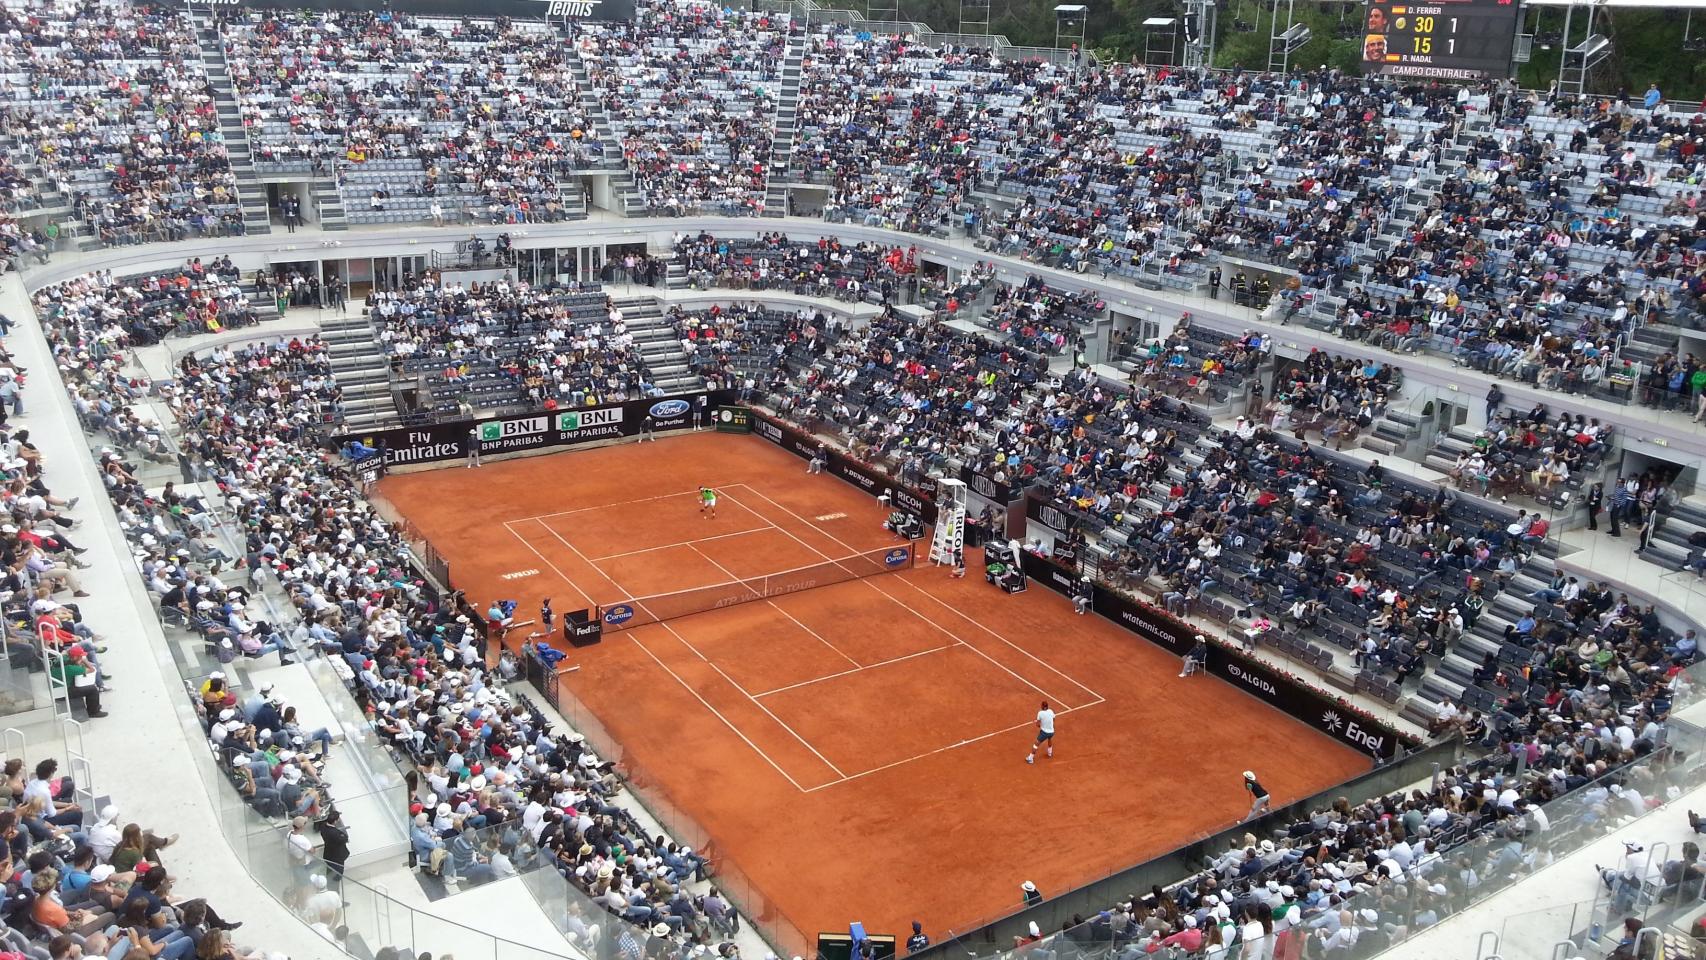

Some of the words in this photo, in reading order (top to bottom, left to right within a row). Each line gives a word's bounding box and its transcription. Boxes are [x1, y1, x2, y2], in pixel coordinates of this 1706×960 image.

[546, 1, 593, 16] Tennis
[1414, 16, 1434, 33] 30
[1450, 17, 1458, 33] 1
[1413, 37, 1431, 54] 15
[1448, 38, 1455, 54] 1
[1392, 65, 1424, 76] CAMPO
[1425, 69, 1471, 79] CENTRALE
[656, 402, 684, 415] Ford
[581, 410, 618, 425] BNL
[504, 419, 544, 435] BNL
[560, 431, 579, 440] BNP
[580, 426, 619, 437] PARIBAS
[409, 432, 431, 443] Fly
[481, 441, 502, 450] BNP
[503, 434, 544, 448] PARIBAS
[385, 442, 459, 464] Emirates
[356, 457, 382, 471] RICOH
[848, 469, 875, 487] DUNLOP
[897, 490, 922, 509] RICOH
[885, 554, 908, 564] Corona
[604, 611, 633, 622] Corona
[1122, 610, 1176, 644] wtatennis.com
[1241, 672, 1276, 696] ALGIDA
[1345, 721, 1384, 750] Enel
